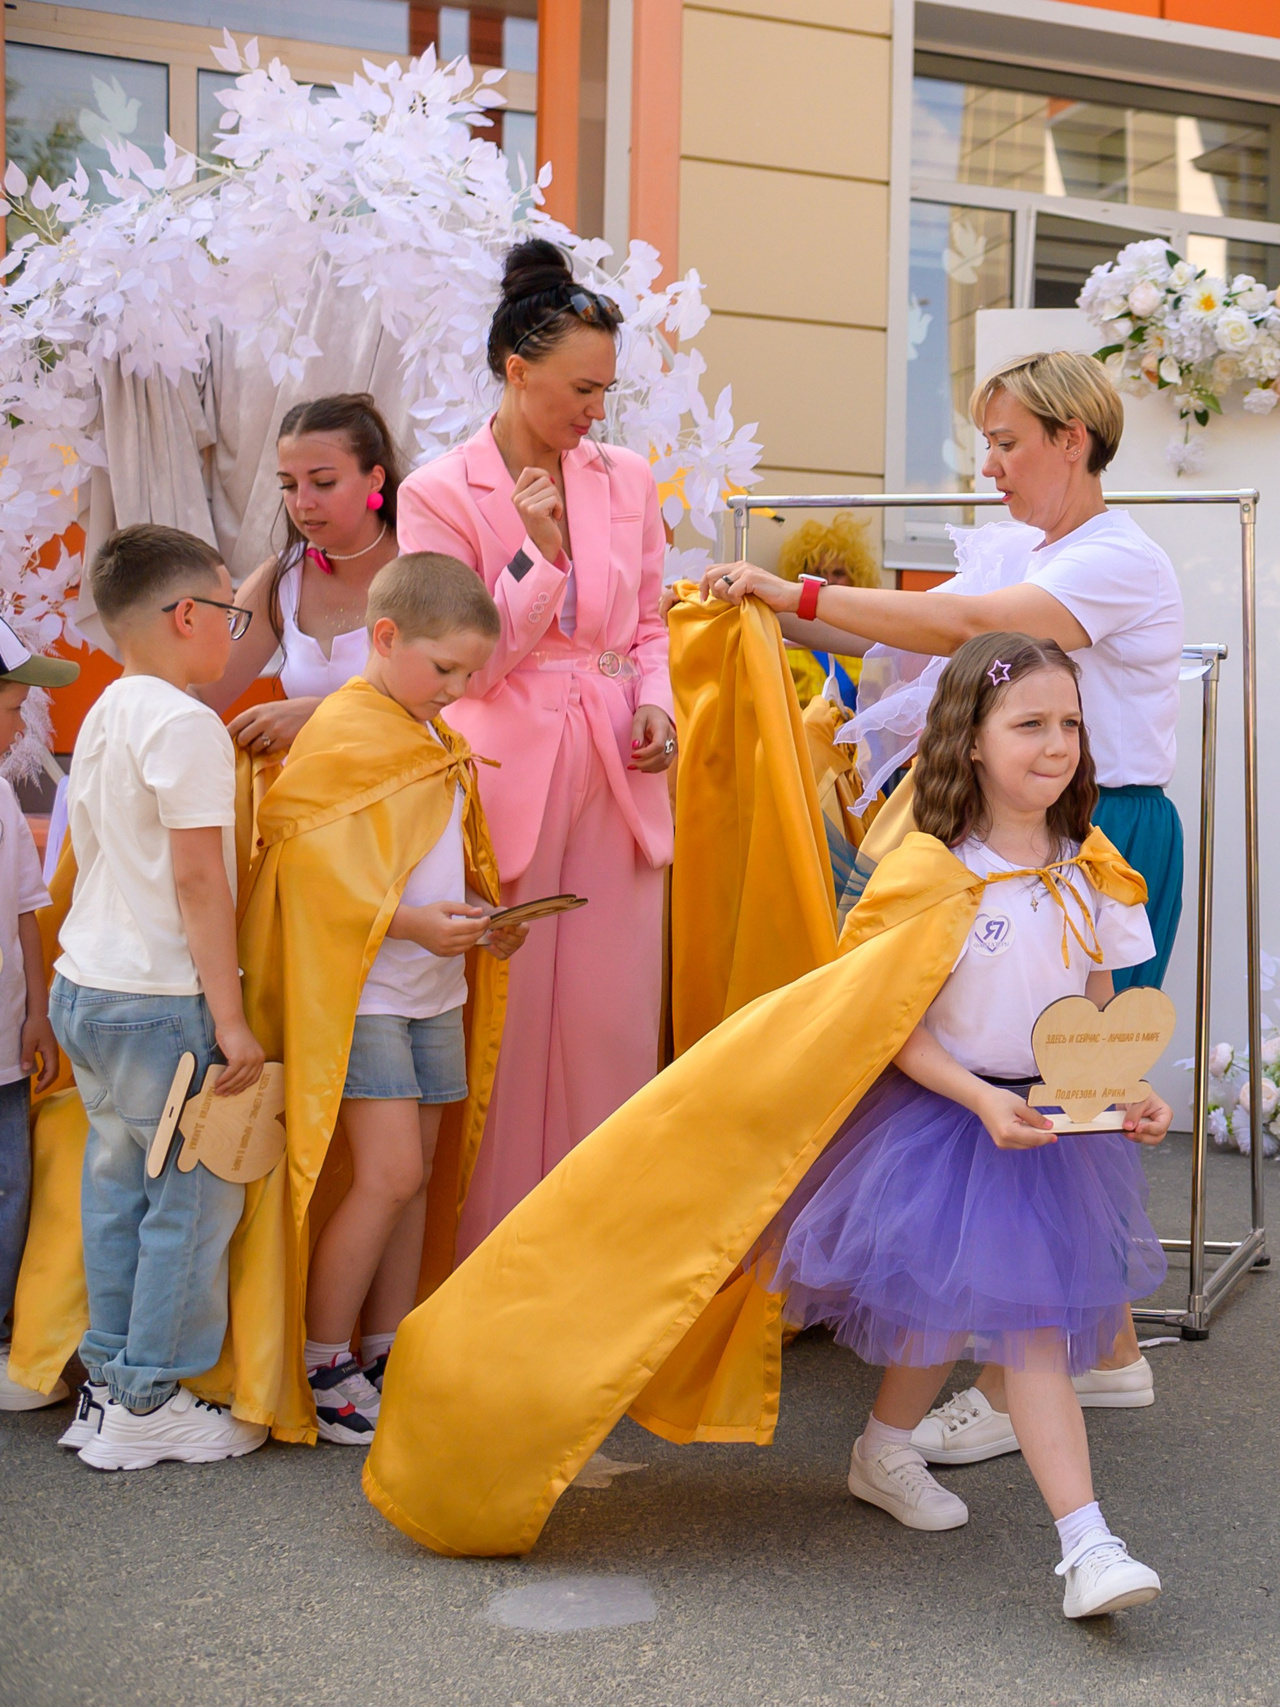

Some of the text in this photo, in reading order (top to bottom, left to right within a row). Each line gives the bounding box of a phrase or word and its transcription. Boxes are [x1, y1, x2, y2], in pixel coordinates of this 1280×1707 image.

[983, 920, 1005, 940] Я
[1045, 1034, 1067, 1045] ЗДЕСЬ
[1068, 1033, 1074, 1043] И
[1075, 1032, 1101, 1044] СЕЙЧАС
[1107, 1032, 1135, 1043] ЛУЧШАЯ
[1135, 1032, 1140, 1042] В
[1141, 1032, 1161, 1042] МИРЕ
